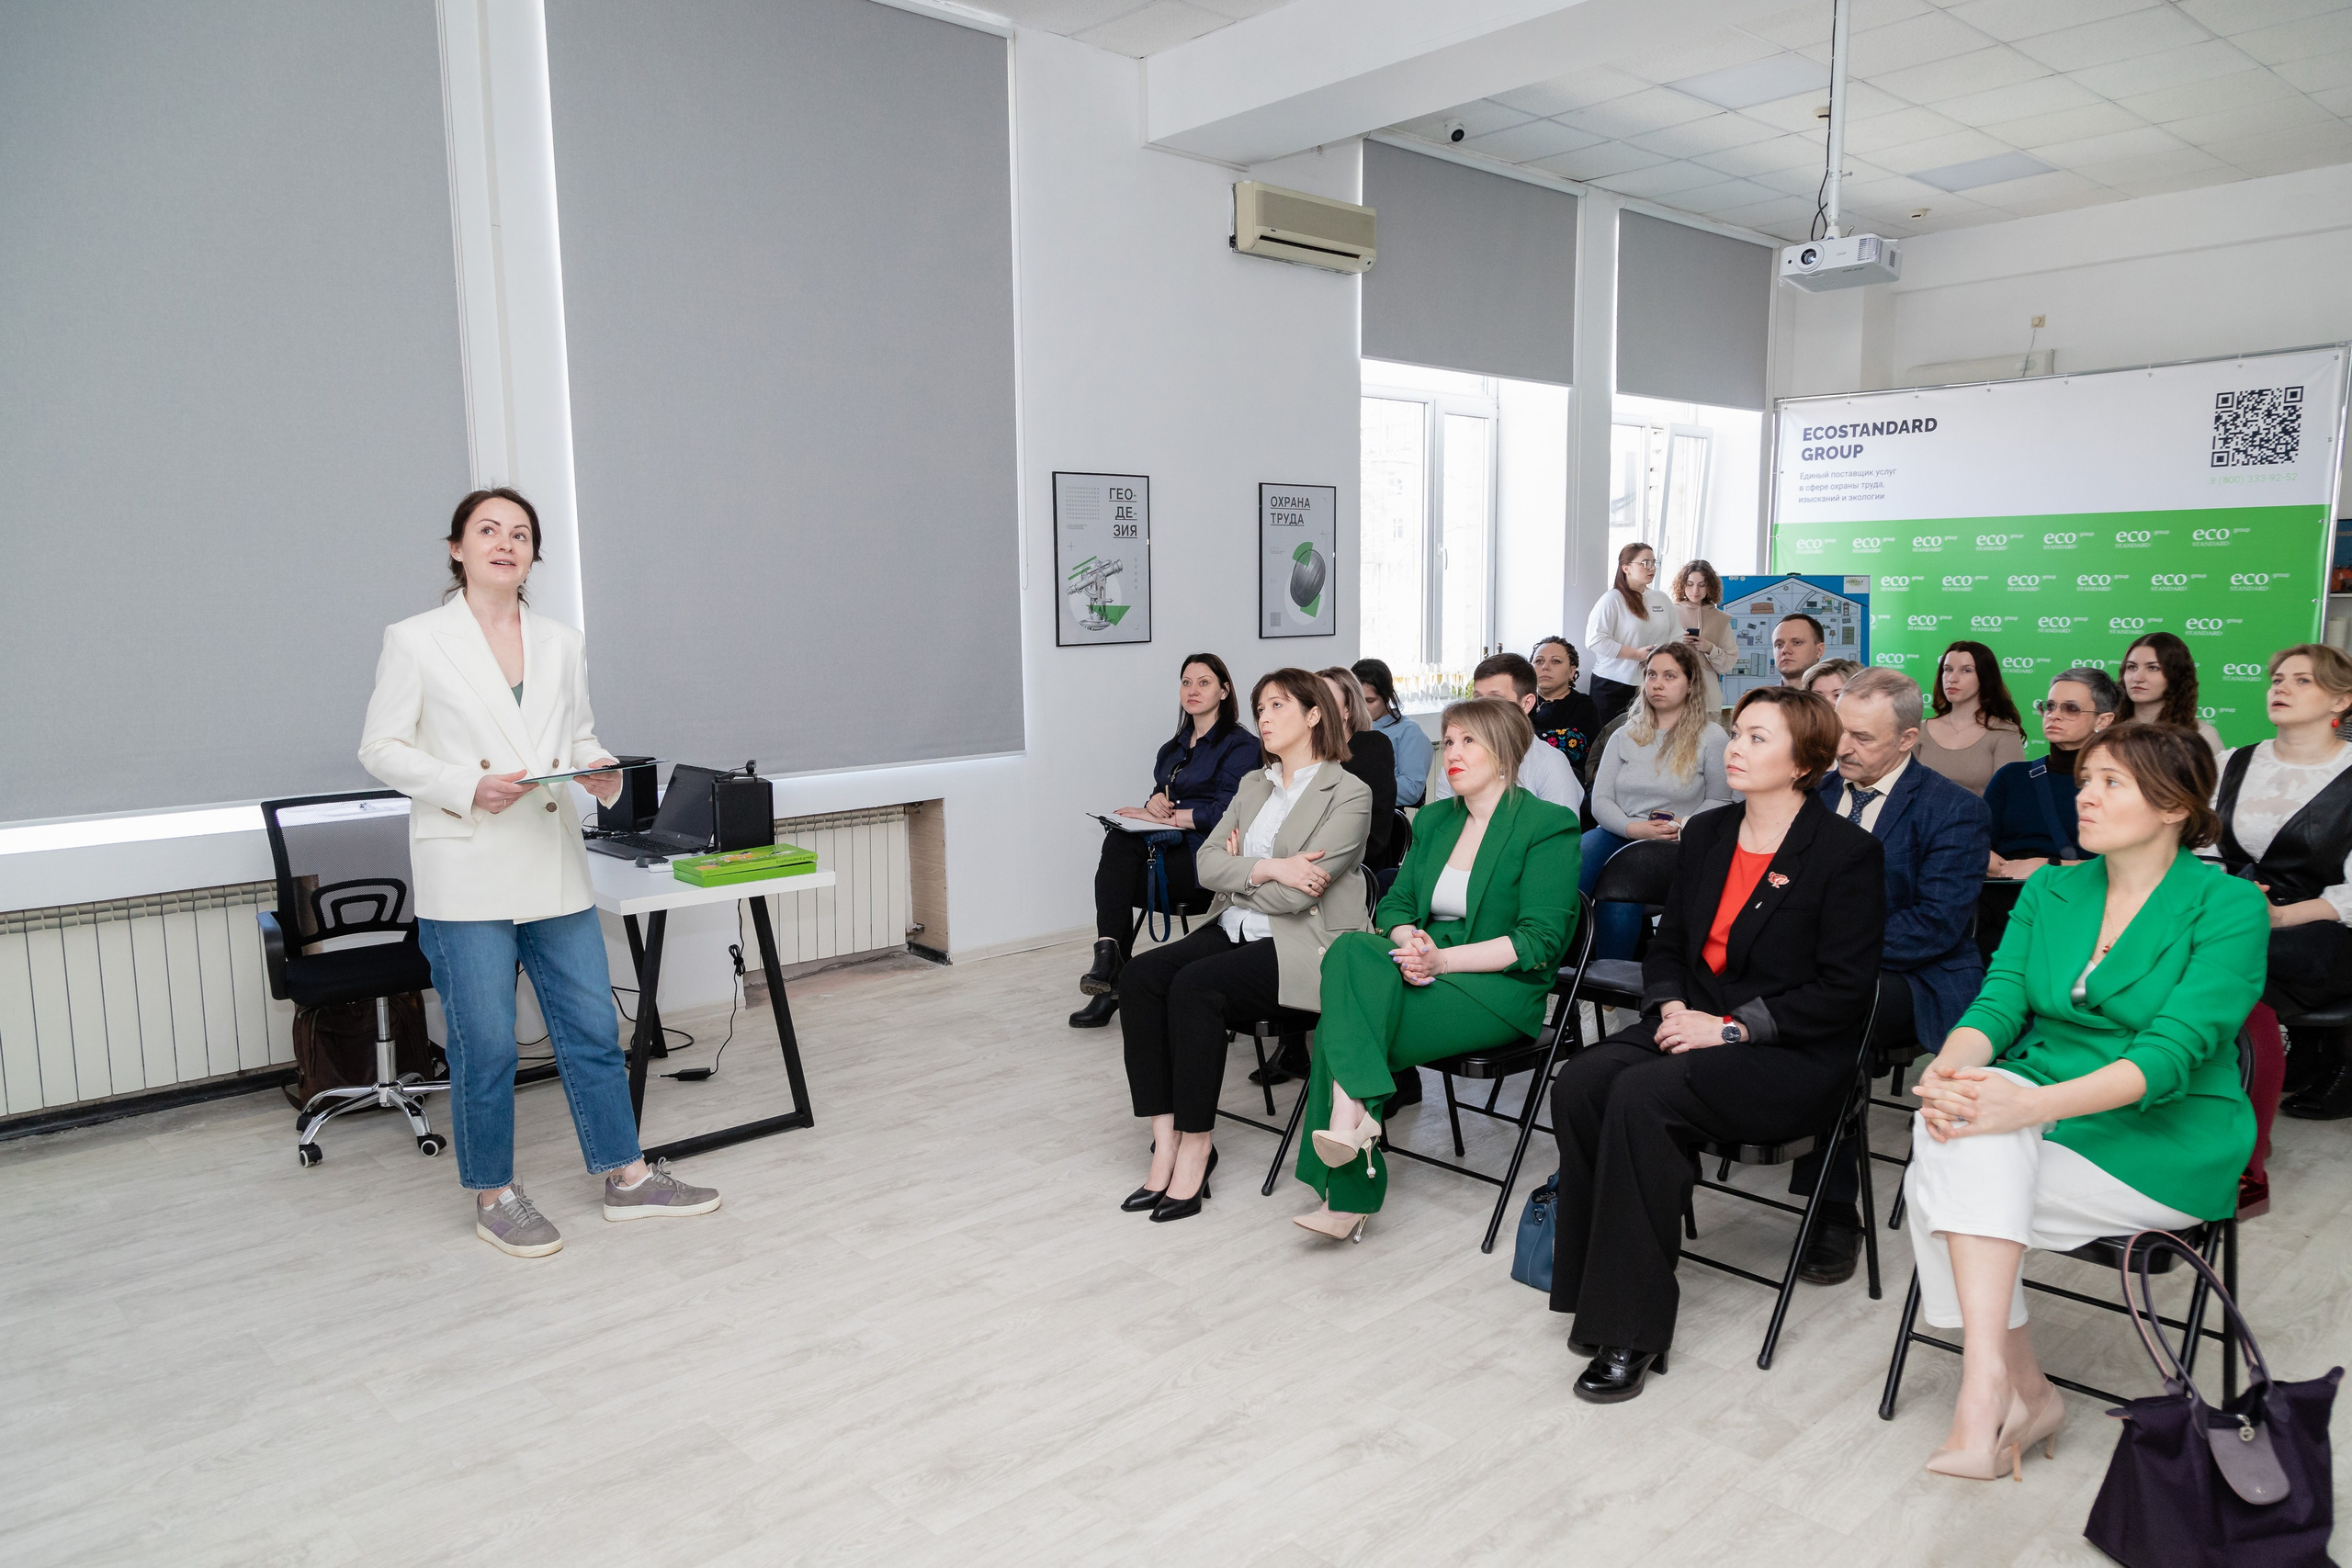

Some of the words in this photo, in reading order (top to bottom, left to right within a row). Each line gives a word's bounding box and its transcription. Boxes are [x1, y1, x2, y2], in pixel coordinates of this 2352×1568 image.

[1803, 418, 1938, 441] ECOSTANDARD
[1802, 445, 1864, 461] GROUP
[1800, 471, 1829, 480] Единый
[1831, 469, 1874, 479] поставщик
[1875, 468, 1897, 478] услуг
[2219, 475, 2244, 485] (800)
[2248, 473, 2298, 483] 333-92-52
[1805, 483, 1829, 492] сфере
[1830, 482, 1860, 491] охраны
[1860, 481, 1885, 490] труда,
[1109, 488, 1136, 501] ГЕО-
[1798, 494, 1840, 503] изысканий
[1849, 493, 1885, 502] экологии
[1271, 496, 1310, 508] ОХРАНА
[1115, 506, 1137, 520] ДЕ-
[1271, 513, 1304, 525] ТРУДА
[1114, 525, 1137, 536] ЗИЯ
[2192, 528, 2230, 541] eco
[1913, 536, 1941, 547] eco
[1976, 535, 2007, 546] eco
[2044, 533, 2076, 544] eco
[2116, 531, 2151, 542] eco
[1796, 538, 1823, 548] eco
[1853, 537, 1881, 548] eco
[1881, 576, 1909, 587] eco
[1942, 575, 1973, 586] eco
[2007, 575, 2039, 586] eco
[2076, 574, 2110, 586] eco
[2151, 574, 2187, 585] eco
[2230, 573, 2268, 585] eco
[1908, 615, 1937, 626] eco
[1972, 615, 2001, 626] eco
[2038, 616, 2071, 627] eco
[2109, 617, 2144, 628] eco
[2186, 618, 2222, 630] eco
[1876, 653, 1904, 664] eco
[2003, 657, 2033, 668] eco
[2072, 659, 2104, 670] eco
[2223, 663, 2261, 675] eco
[2196, 707, 2215, 717] co
